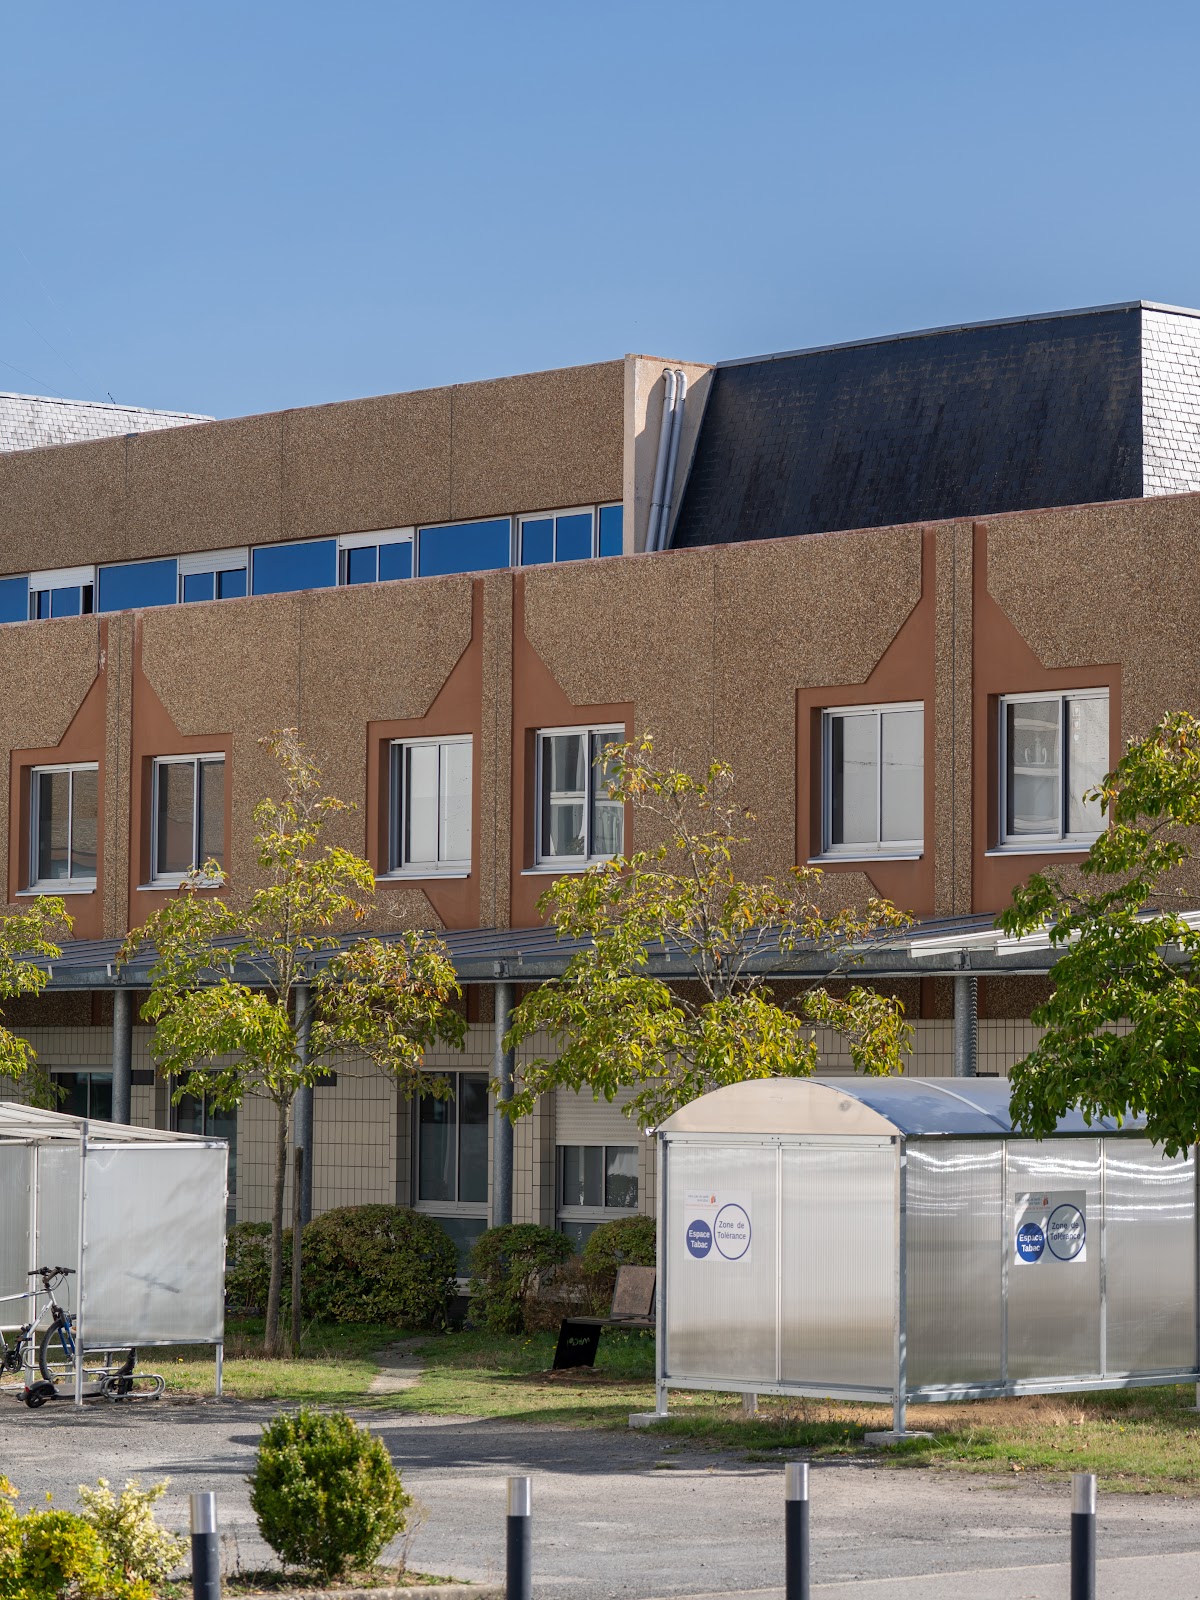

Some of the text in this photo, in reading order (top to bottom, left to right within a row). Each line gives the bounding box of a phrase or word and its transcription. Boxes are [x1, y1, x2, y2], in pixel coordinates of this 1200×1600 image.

[1052, 1222, 1068, 1230] Zone
[689, 1230, 710, 1239] Espace
[717, 1231, 746, 1239] Tolérance
[1019, 1234, 1042, 1243] Espace
[690, 1240, 708, 1248] Tabac
[1021, 1244, 1041, 1252] Tabac
